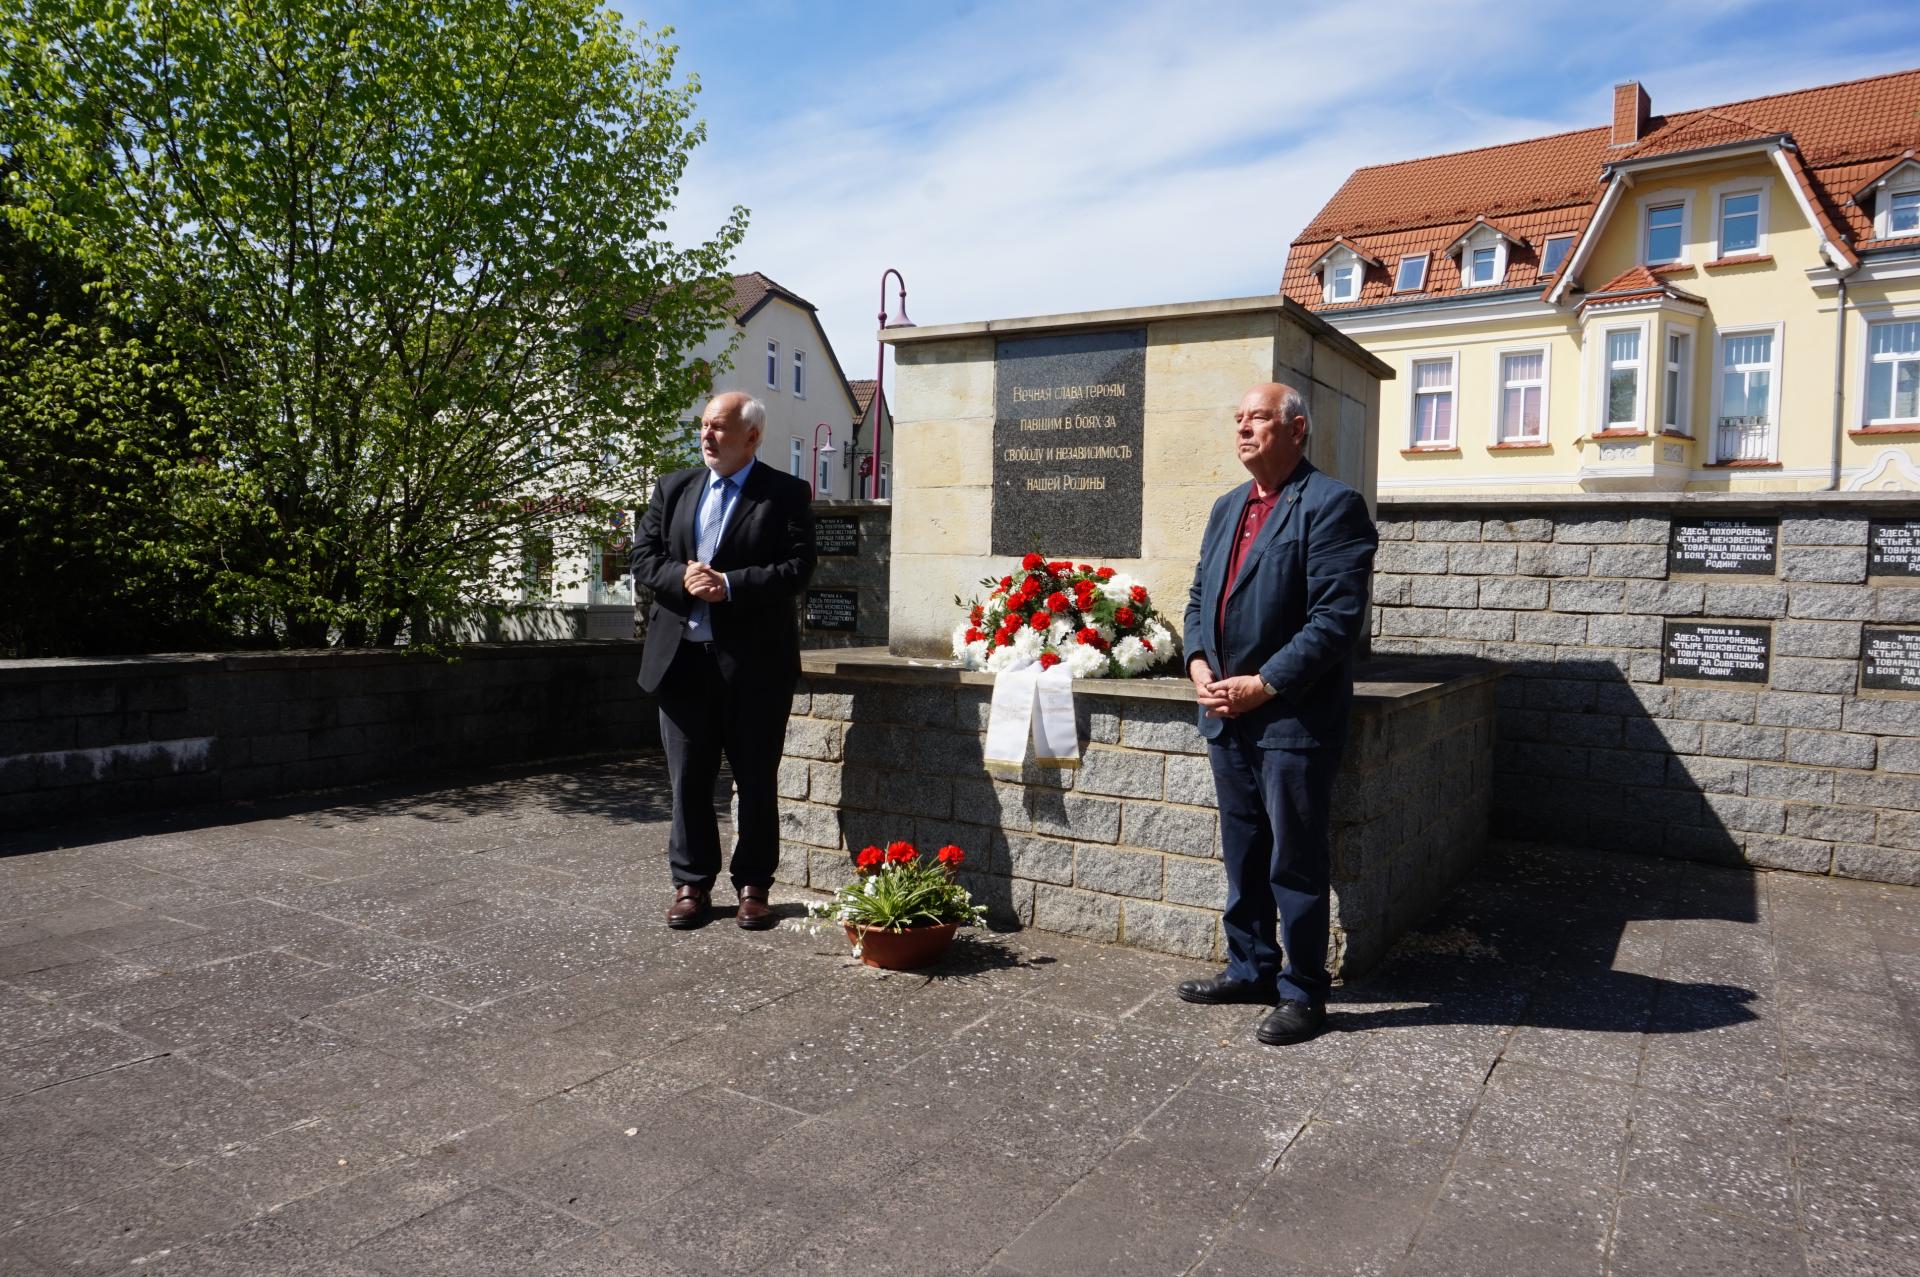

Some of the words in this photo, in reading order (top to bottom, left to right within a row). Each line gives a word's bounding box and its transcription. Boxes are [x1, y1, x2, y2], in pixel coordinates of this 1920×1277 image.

[1013, 386, 1052, 402] Вечная
[1054, 386, 1083, 400] слава
[1086, 383, 1126, 398] героям
[1020, 417, 1062, 432] павшим
[1075, 414, 1102, 429] боях
[1104, 415, 1117, 428] за
[1004, 446, 1044, 462] свободу
[1056, 445, 1132, 460] независимость
[1027, 476, 1060, 491] нашей
[1063, 474, 1106, 490] Родины
[1709, 527, 1770, 536] ПОХОРОНЕНЫ:
[1676, 535, 1710, 544] ЧЕТЫРЕ
[1712, 536, 1774, 544] НЕИЗВЕСТНЫХ
[1874, 538, 1913, 546] ЧЕТЫРЕ
[1730, 544, 1766, 553] ПАВШИХ
[1676, 551, 1682, 559] В
[1684, 552, 1706, 560] БОЯХ
[1708, 552, 1719, 560] ЗА
[1883, 555, 1908, 563] БОЯХ
[1703, 635, 1763, 645] ПОХОРОНЕНЫ:
[1670, 641, 1703, 650] ЧЕТЫРЕ
[1705, 643, 1766, 653] НЕИЗВЕСТНЫХ
[1723, 652, 1759, 661] ПАВШИХ
[1867, 649, 1906, 659] ЧЕТЫРЕ
[1677, 658, 1699, 666] БОЯХ
[1701, 659, 1711, 667] ЗА
[1875, 658, 1920, 668] ТОВАРИЩ
[1867, 666, 1874, 674] В
[1876, 666, 1901, 675] БОЯХ
[1903, 668, 1916, 676] ЗА
